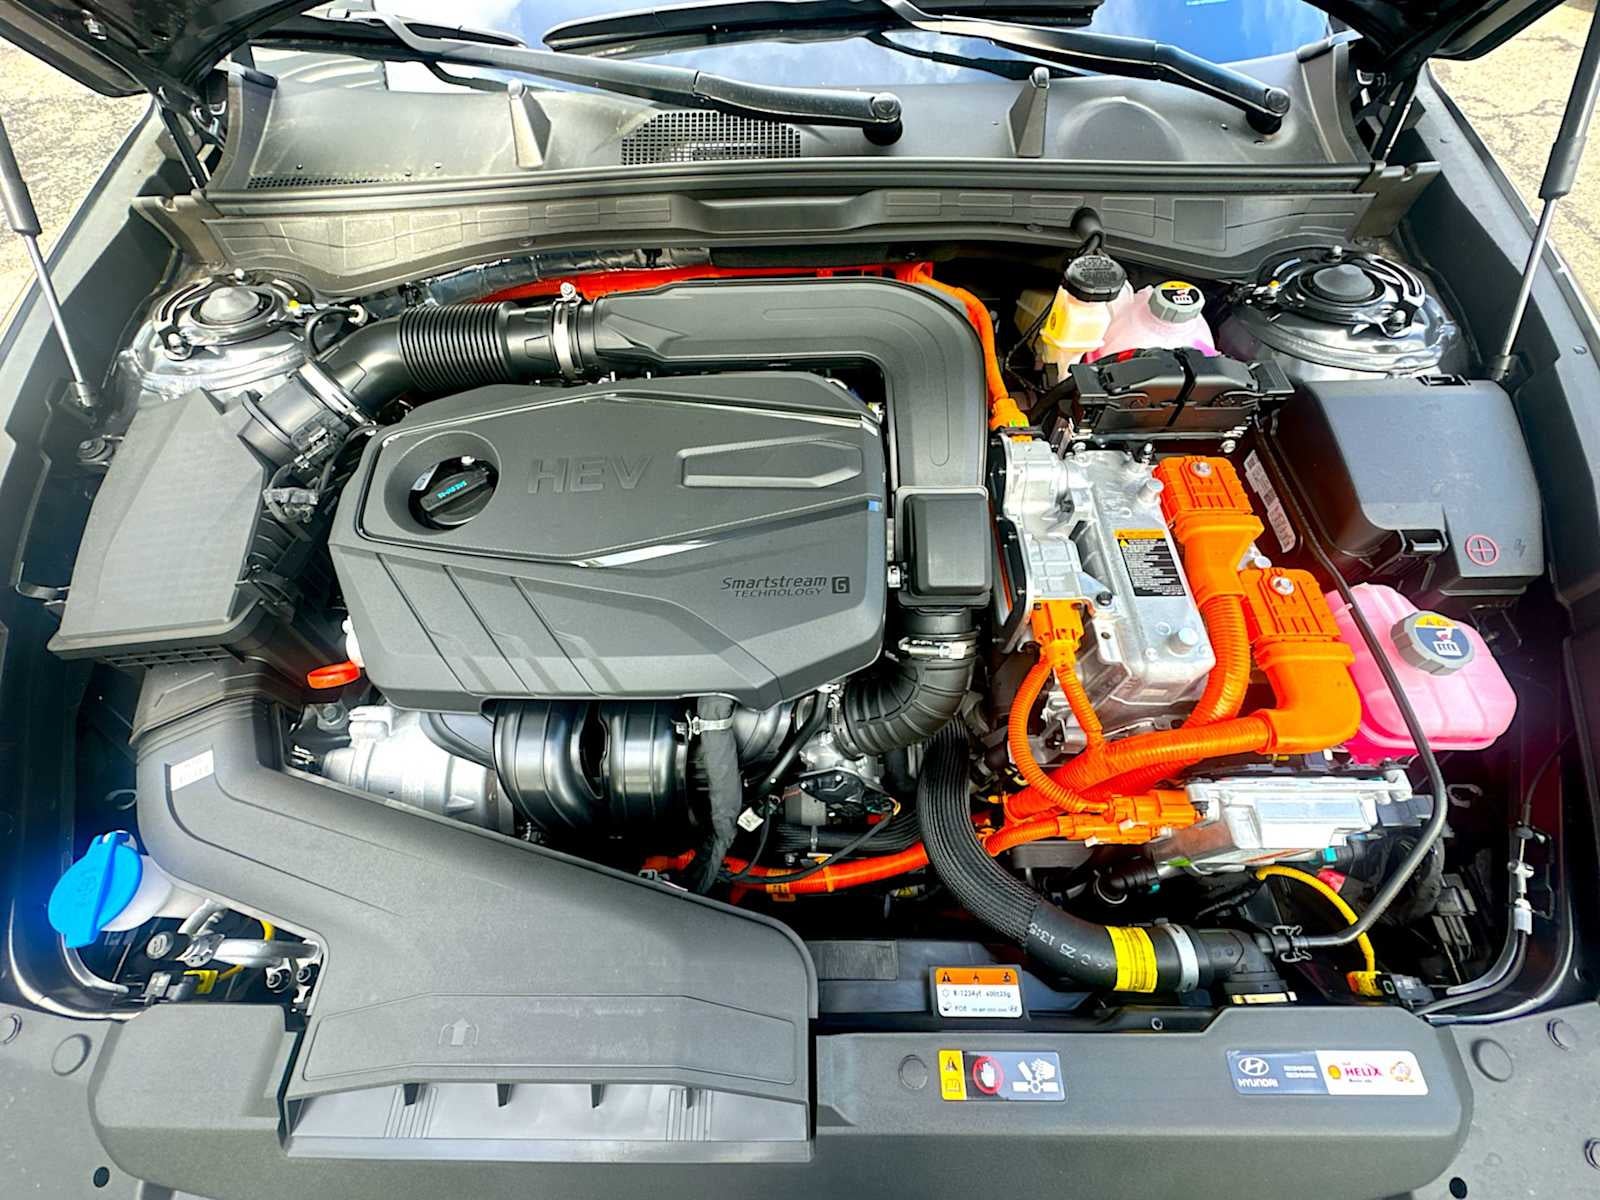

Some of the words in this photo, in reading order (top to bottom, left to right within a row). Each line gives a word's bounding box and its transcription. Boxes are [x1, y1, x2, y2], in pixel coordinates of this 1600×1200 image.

[528, 456, 654, 494] HEV
[721, 576, 827, 590] Smartstream
[833, 577, 848, 593] G
[734, 587, 825, 598] TECHNOLOGY
[1345, 1066, 1383, 1077] HELIX
[1238, 1078, 1279, 1088] HYUNDAI
